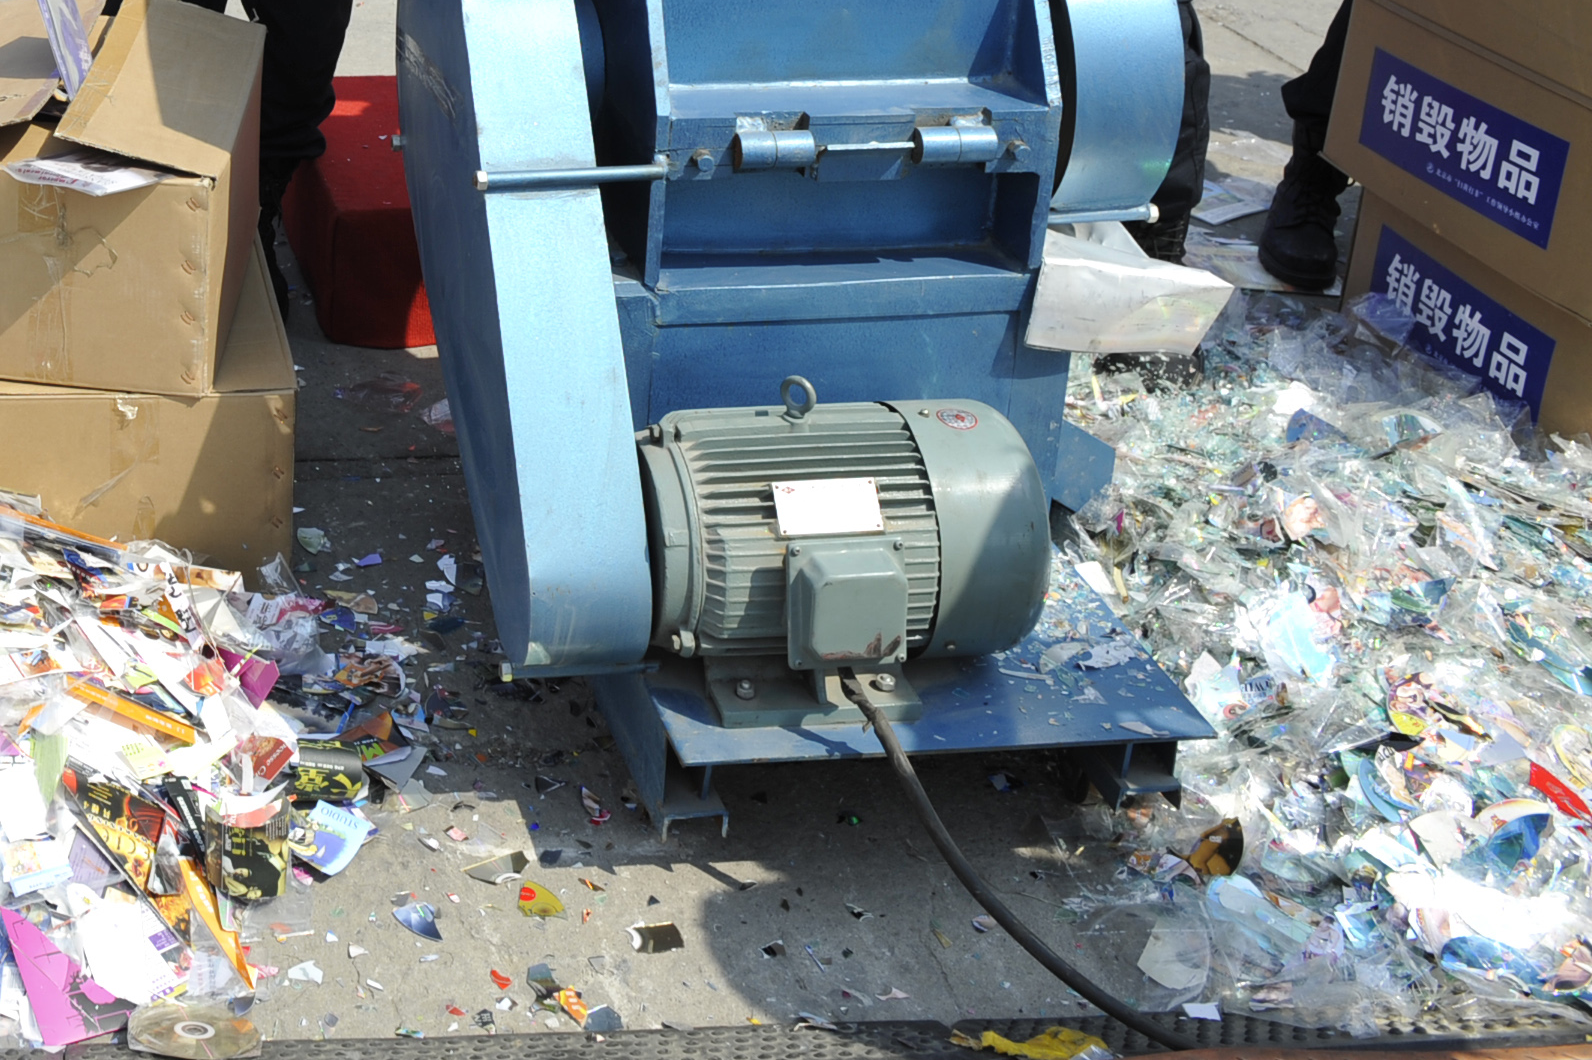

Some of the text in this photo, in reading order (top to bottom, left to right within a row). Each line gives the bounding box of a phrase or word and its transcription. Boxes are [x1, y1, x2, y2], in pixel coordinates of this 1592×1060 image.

[1381, 74, 1541, 205] 销毁物品
[1386, 253, 1529, 398] 销毁物品
[321, 805, 360, 829] STUDIO
